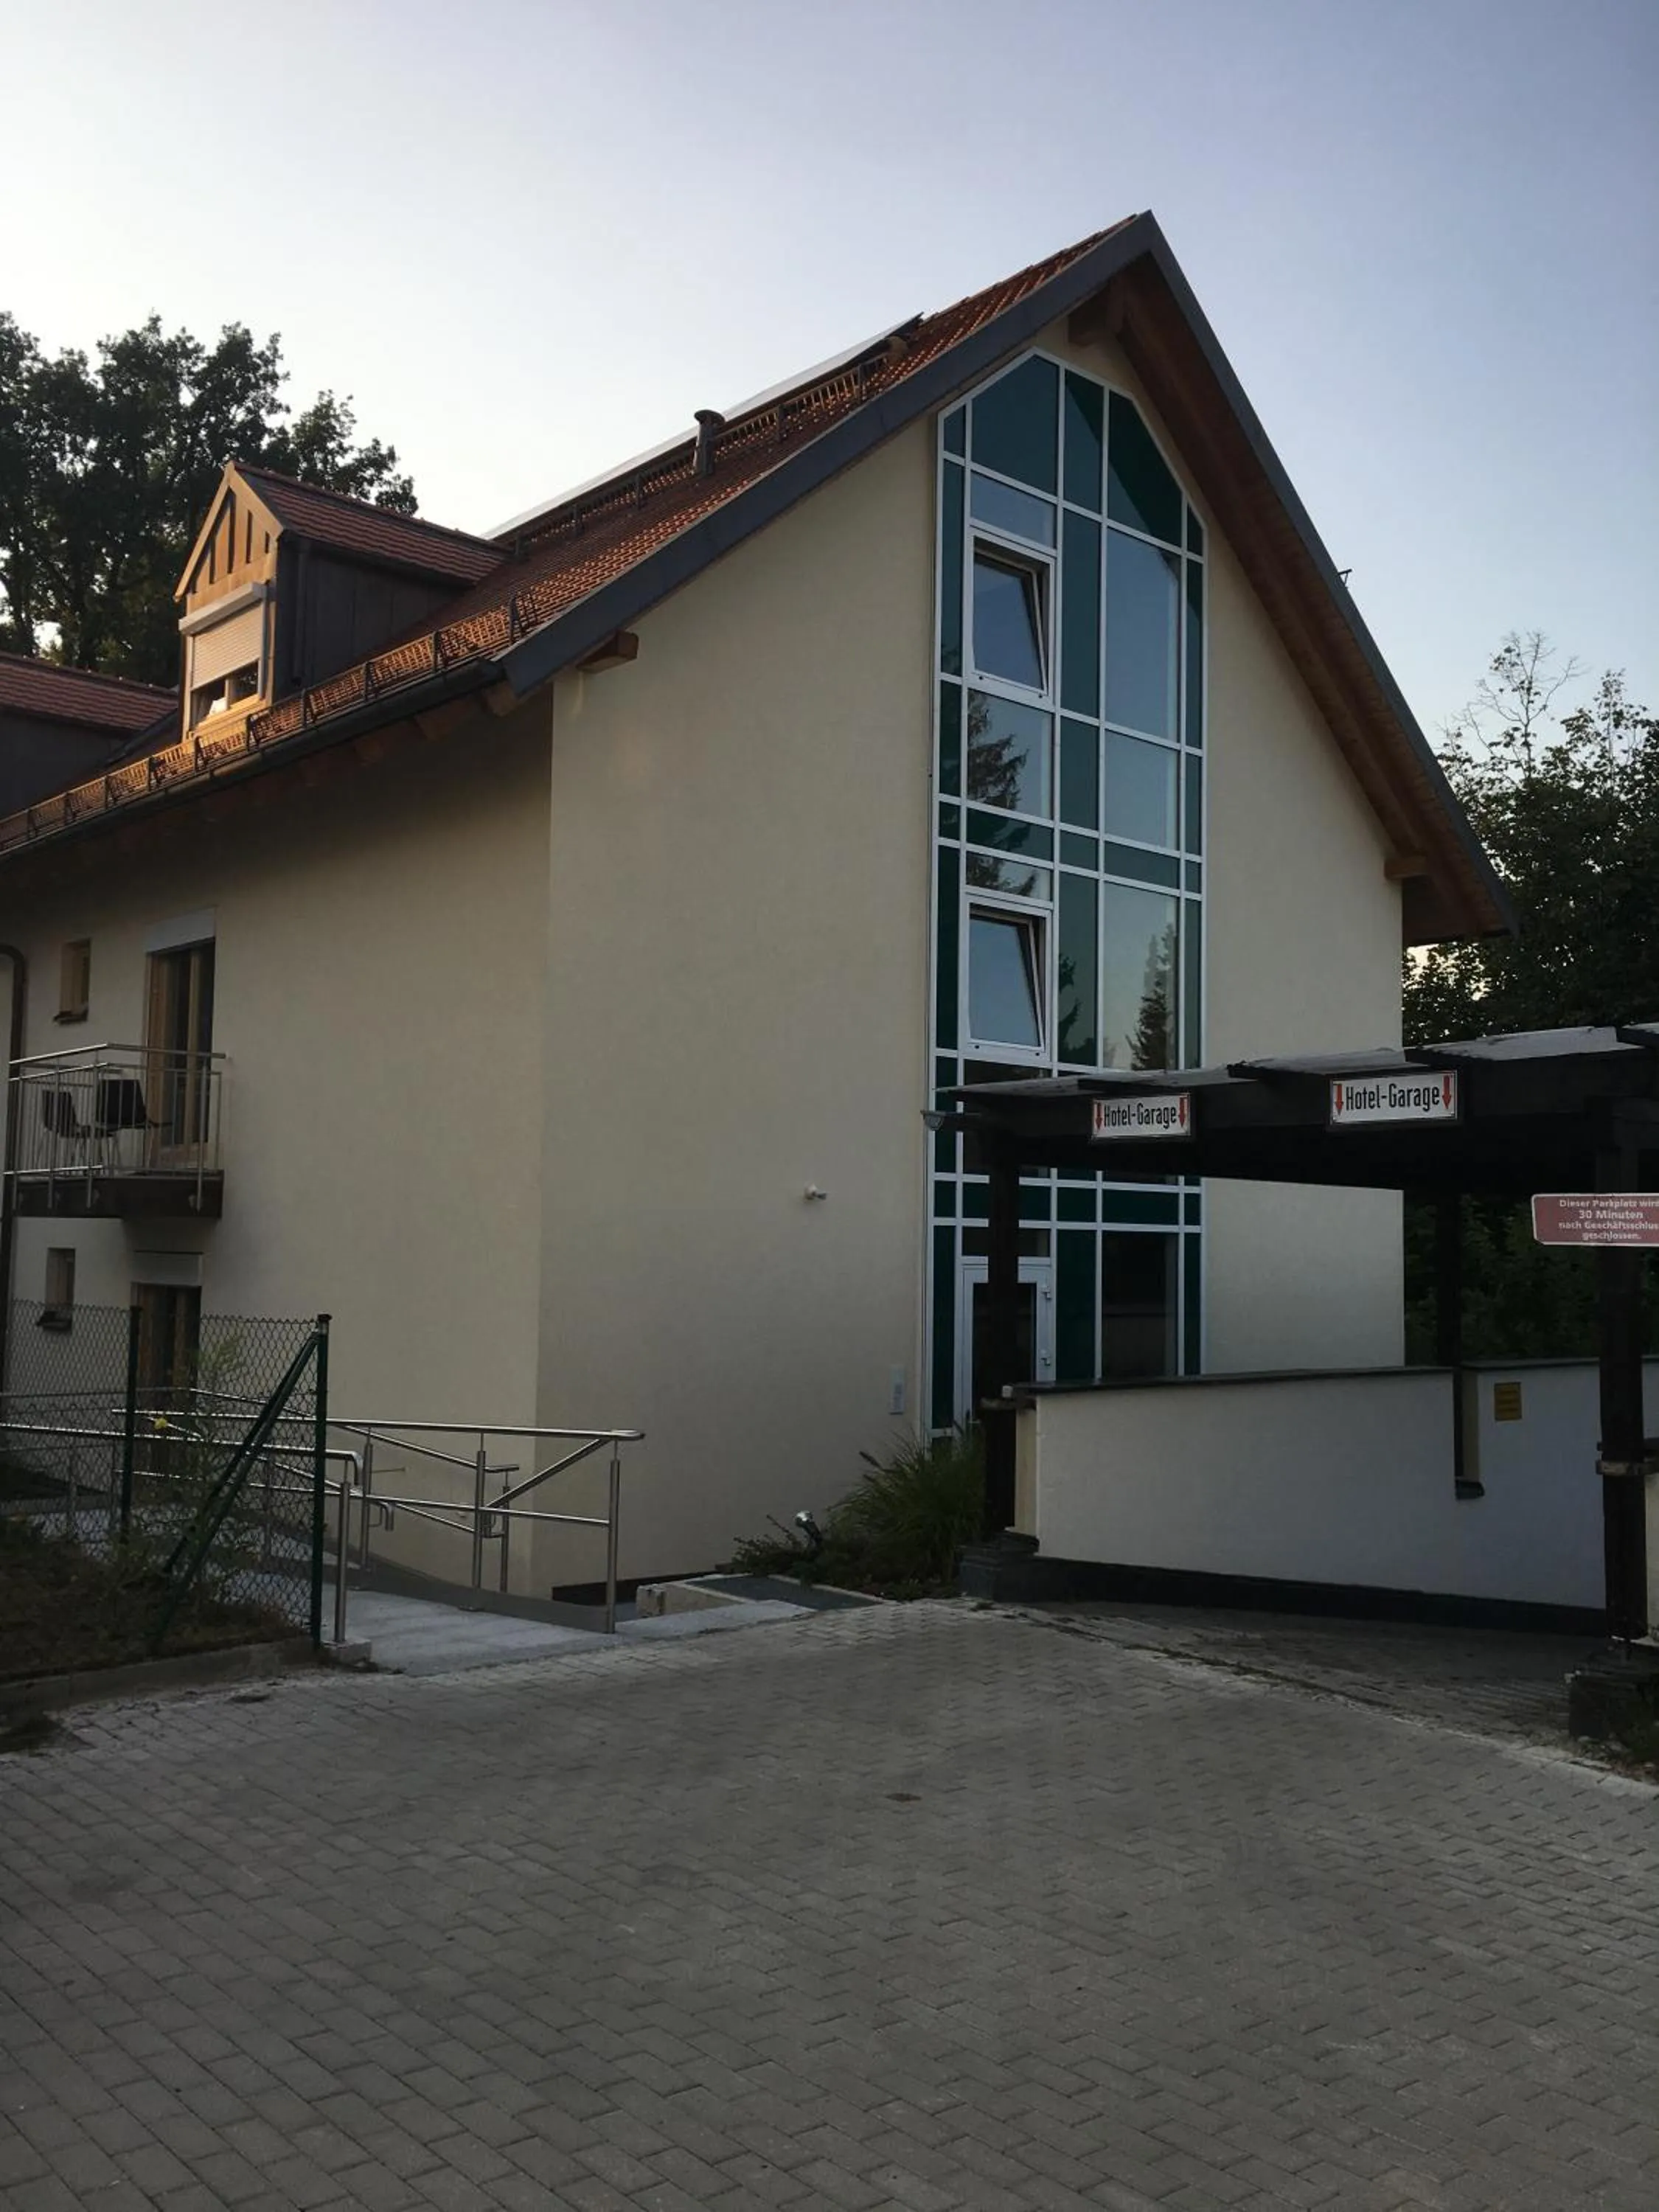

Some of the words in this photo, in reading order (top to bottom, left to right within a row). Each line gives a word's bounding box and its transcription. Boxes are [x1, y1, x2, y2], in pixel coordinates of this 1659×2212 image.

[1346, 1083, 1440, 1112] Hotel-Garage
[1104, 1102, 1177, 1129] Hotel-Garage
[1592, 1200, 1638, 1208] Parkplatz
[1579, 1210, 1593, 1219] 30
[1596, 1211, 1644, 1219] Minuten
[1558, 1221, 1582, 1229] nach
